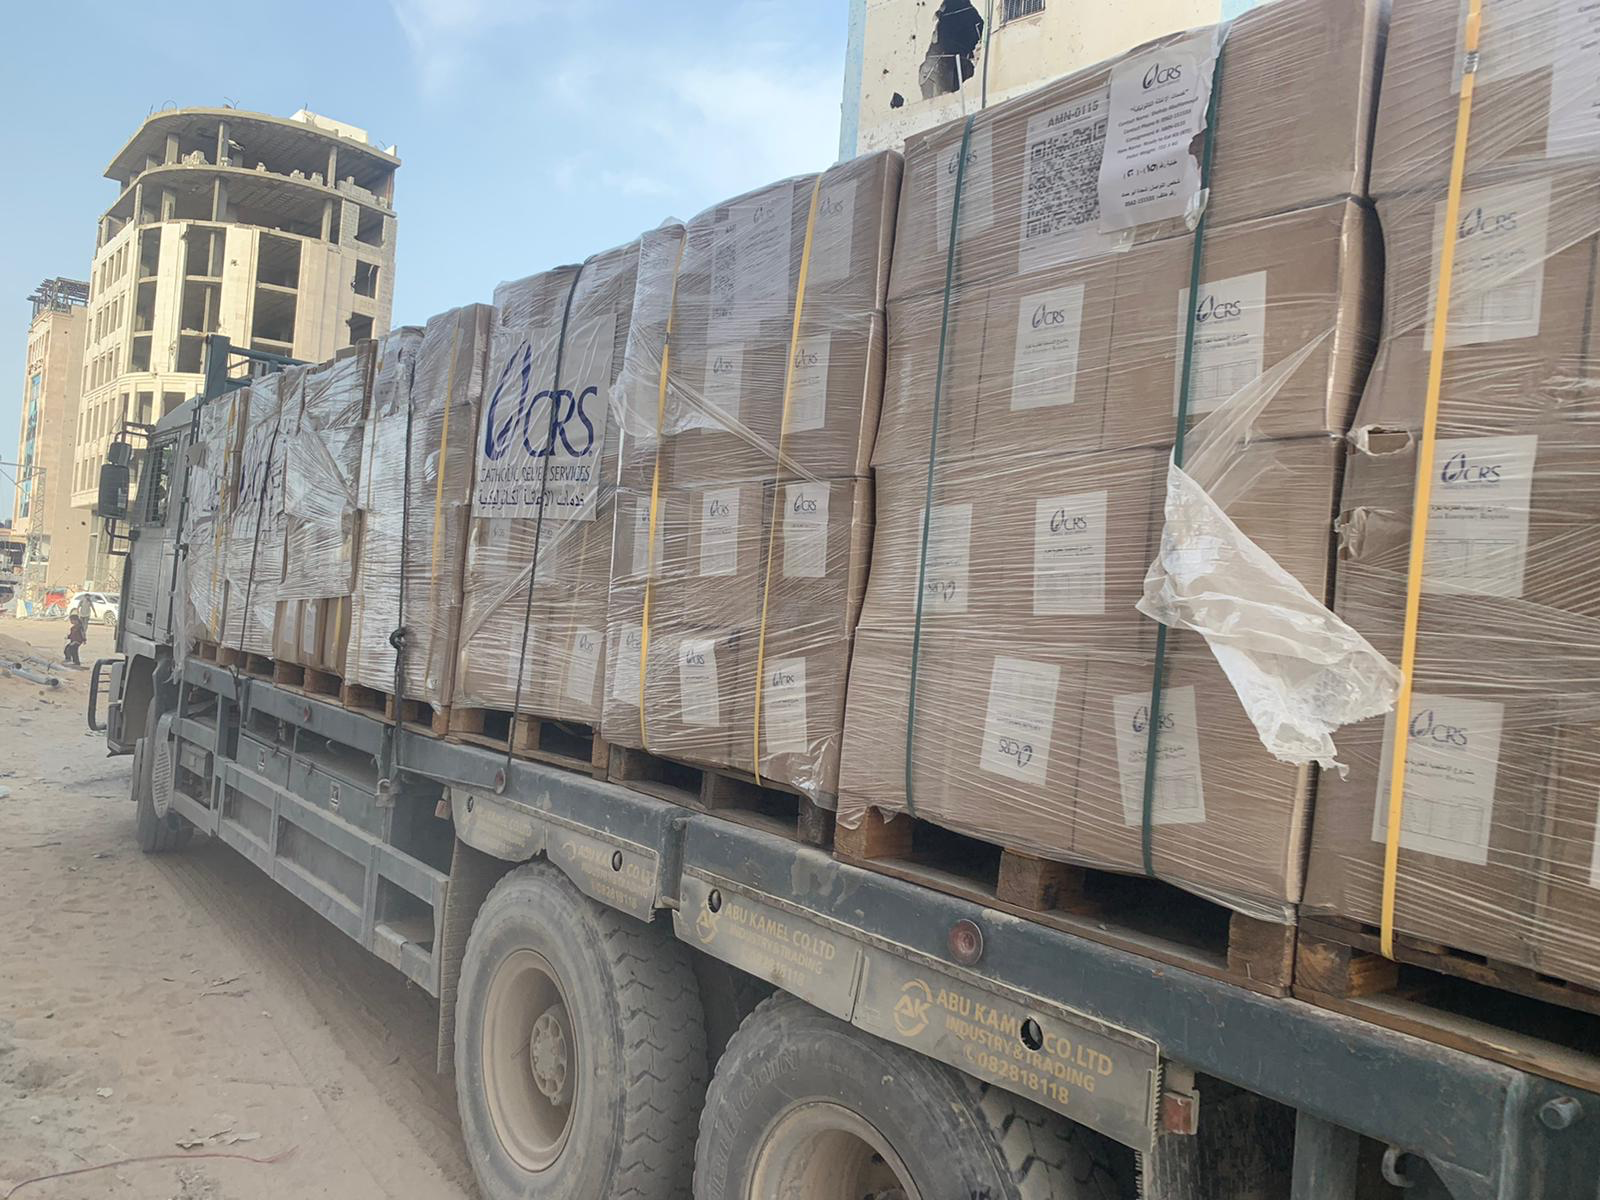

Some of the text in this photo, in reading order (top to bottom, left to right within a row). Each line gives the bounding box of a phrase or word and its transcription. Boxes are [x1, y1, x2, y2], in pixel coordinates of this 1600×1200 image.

[1157, 64, 1182, 84] CRS
[1044, 309, 1065, 326] CRS
[1213, 300, 1241, 319] CRS
[524, 386, 598, 457] CRS
[550, 465, 591, 482] SERVICES
[1464, 465, 1502, 483] CRS
[1064, 516, 1087, 531] CRS
[1432, 724, 1468, 746] CRS
[724, 902, 836, 961] ABU KAMEL CO.LTD
[894, 994, 931, 1025] AK
[936, 988, 971, 1017] ABU
[1043, 1031, 1113, 1077] CO.LTD
[975, 1051, 1070, 1105] 082818118
